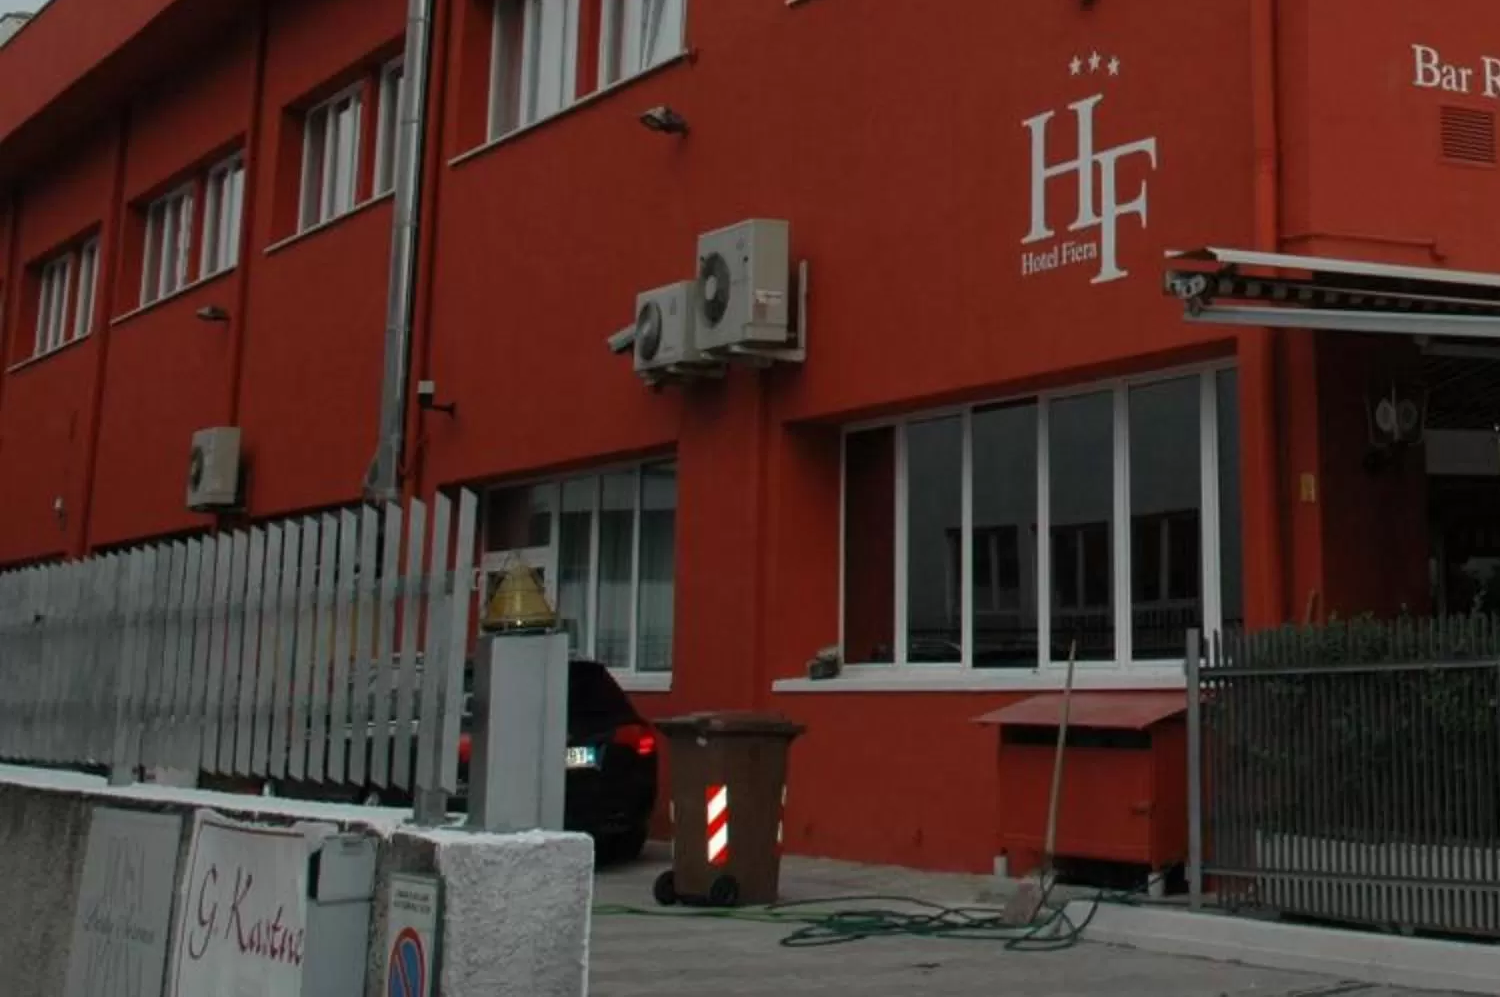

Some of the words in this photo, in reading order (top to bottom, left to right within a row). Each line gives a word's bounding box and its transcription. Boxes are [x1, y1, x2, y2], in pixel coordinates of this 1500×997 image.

[1411, 44, 1473, 95] Bar
[1020, 93, 1157, 284] HF
[1021, 246, 1059, 276] Hotel
[1061, 240, 1097, 266] Fiera
